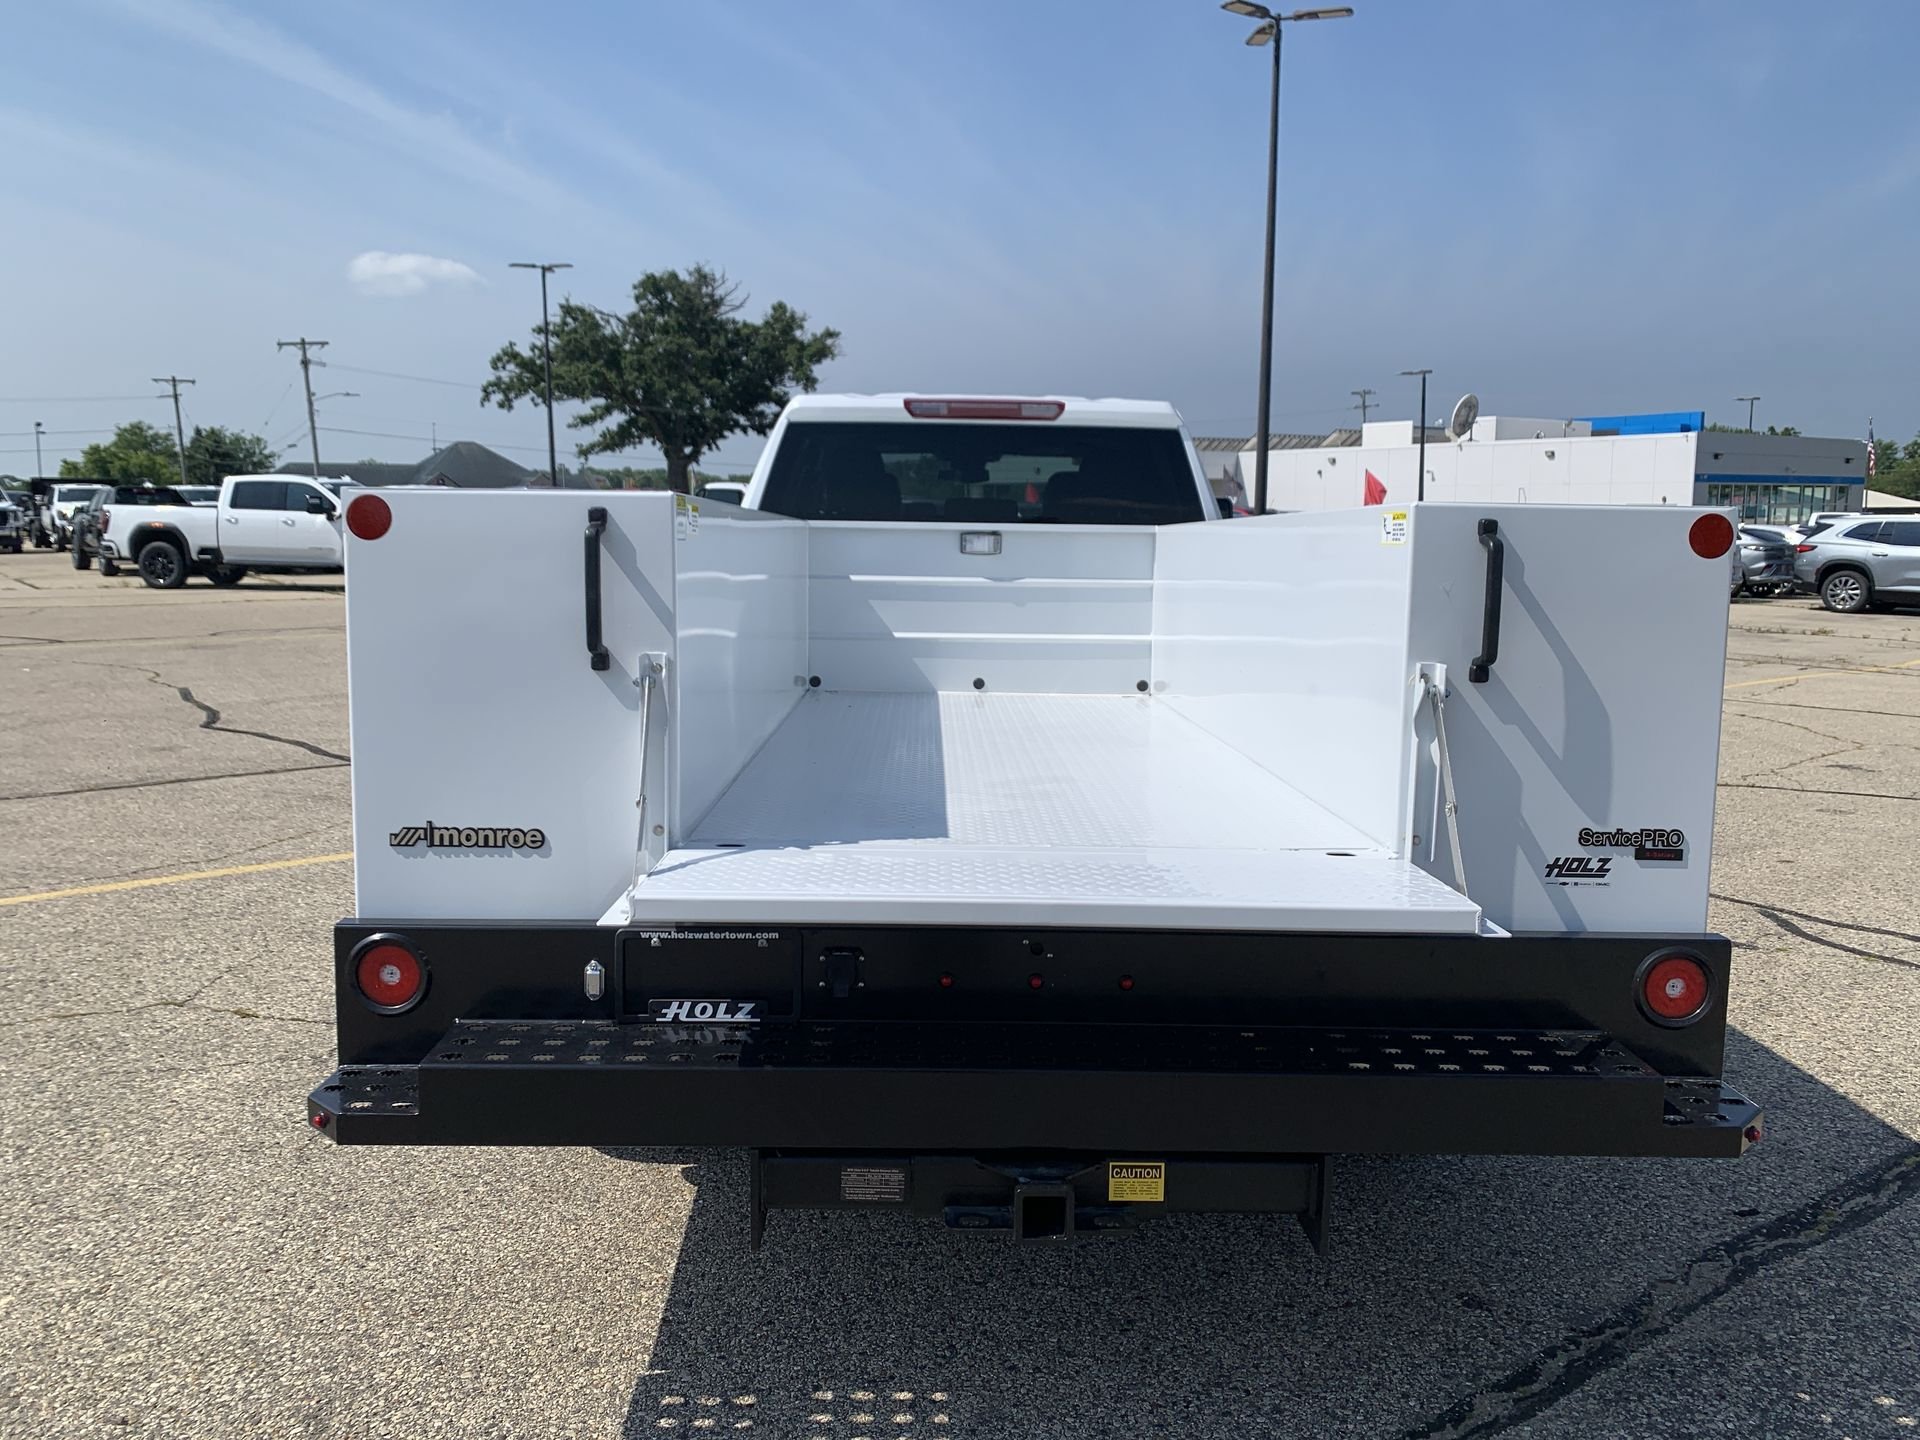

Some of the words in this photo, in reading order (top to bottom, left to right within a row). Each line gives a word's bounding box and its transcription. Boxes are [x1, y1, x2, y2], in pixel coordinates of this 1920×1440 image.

[431, 827, 546, 849] monroe
[1578, 828, 1685, 847] ServicePRO
[1545, 857, 1612, 878] HOLZ
[640, 931, 779, 940] www.holzwatertown.com
[656, 1001, 760, 1022] HOLZ
[1113, 1168, 1160, 1178] CAUTION
